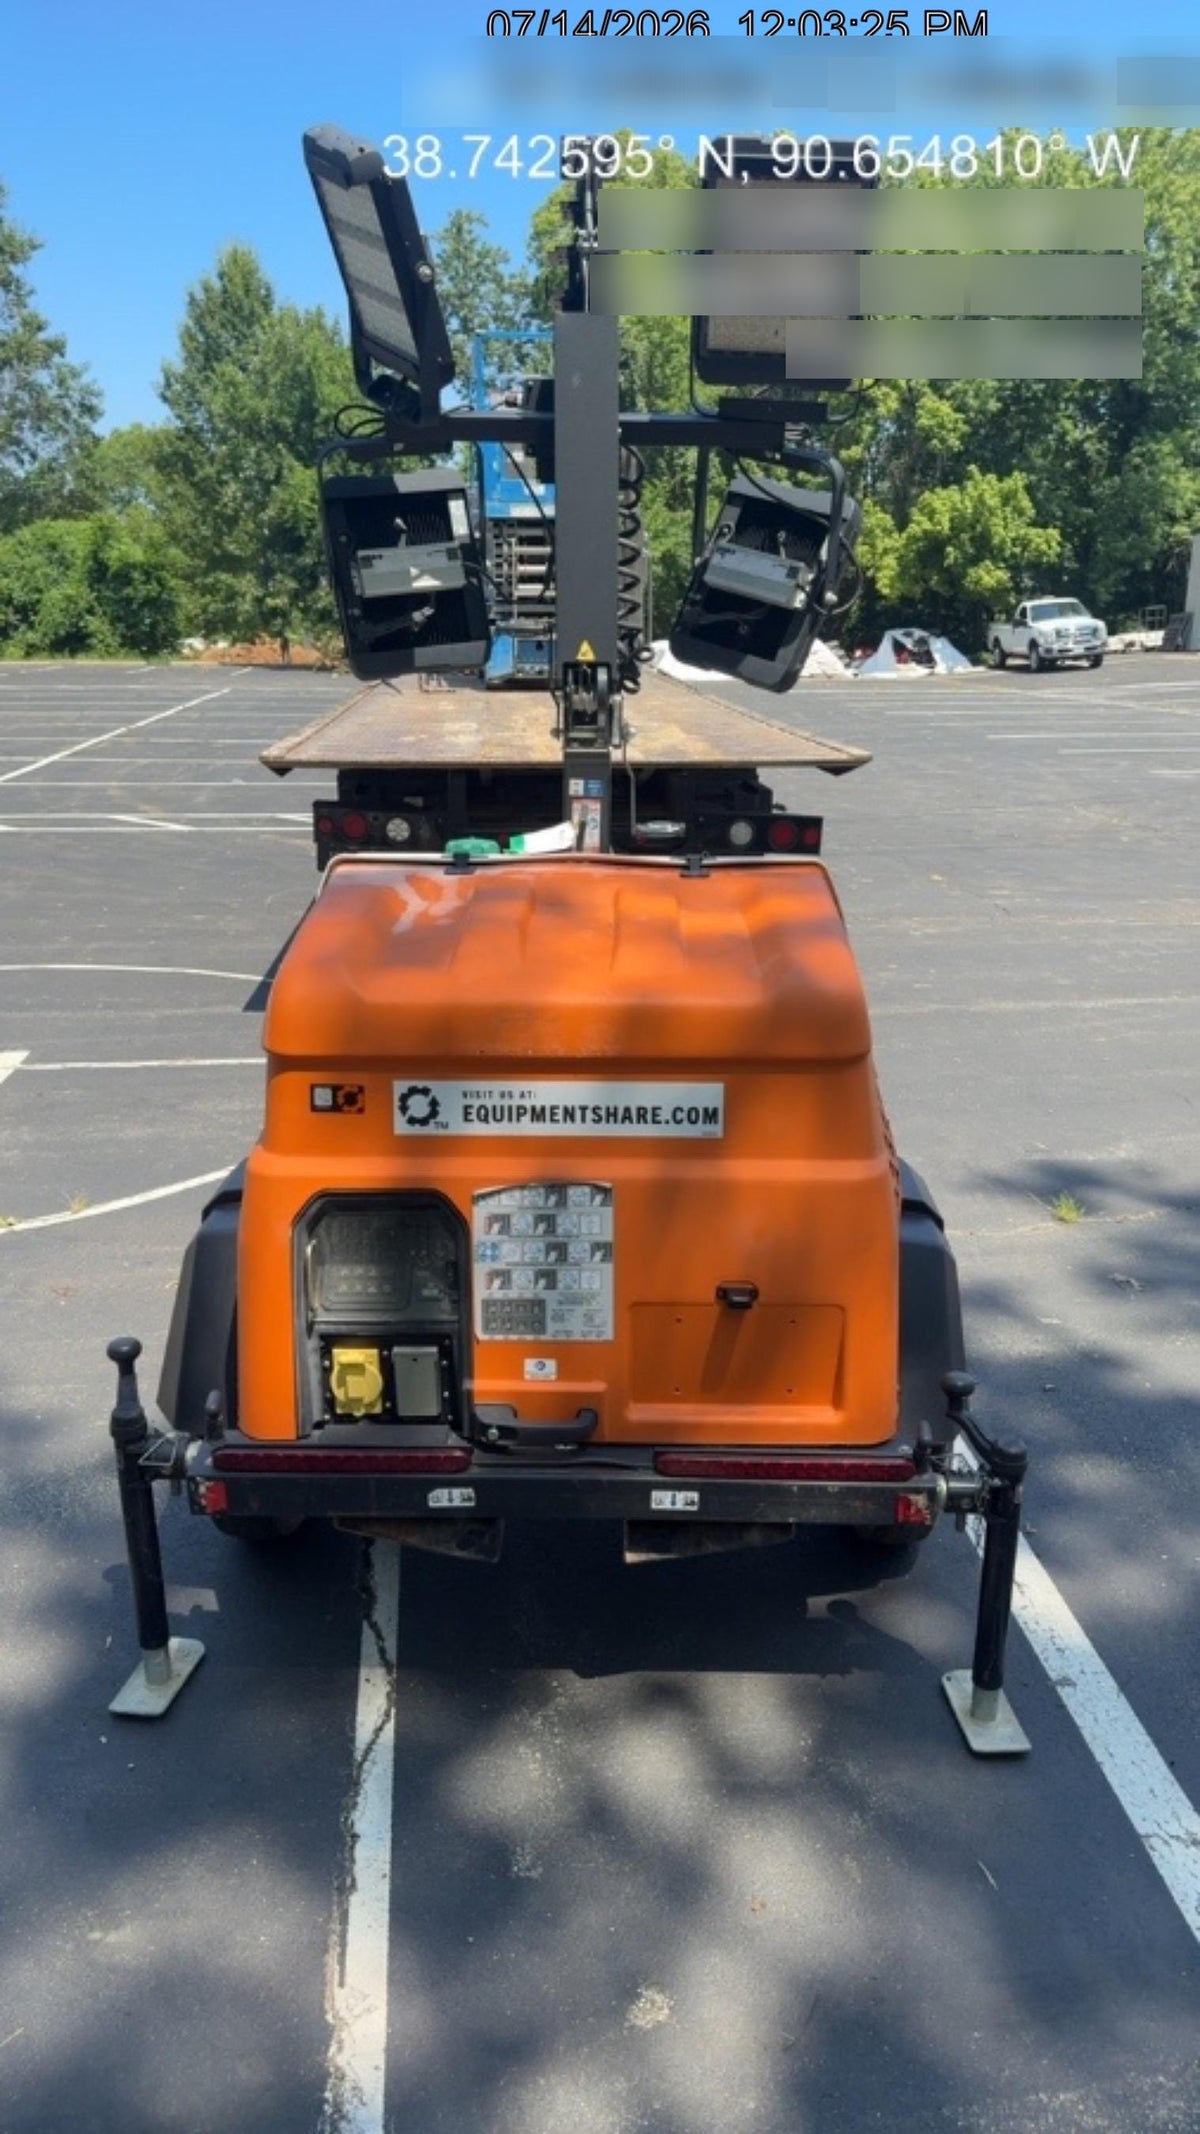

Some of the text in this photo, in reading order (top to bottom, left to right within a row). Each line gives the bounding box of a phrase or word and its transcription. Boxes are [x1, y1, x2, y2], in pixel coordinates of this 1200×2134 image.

[461, 1090, 493, 1100] VISIT
[499, 1090, 515, 1100] US
[462, 1104, 720, 1126] EQUIPMENTSHARE.COM
[433, 1120, 449, 1130] TM
